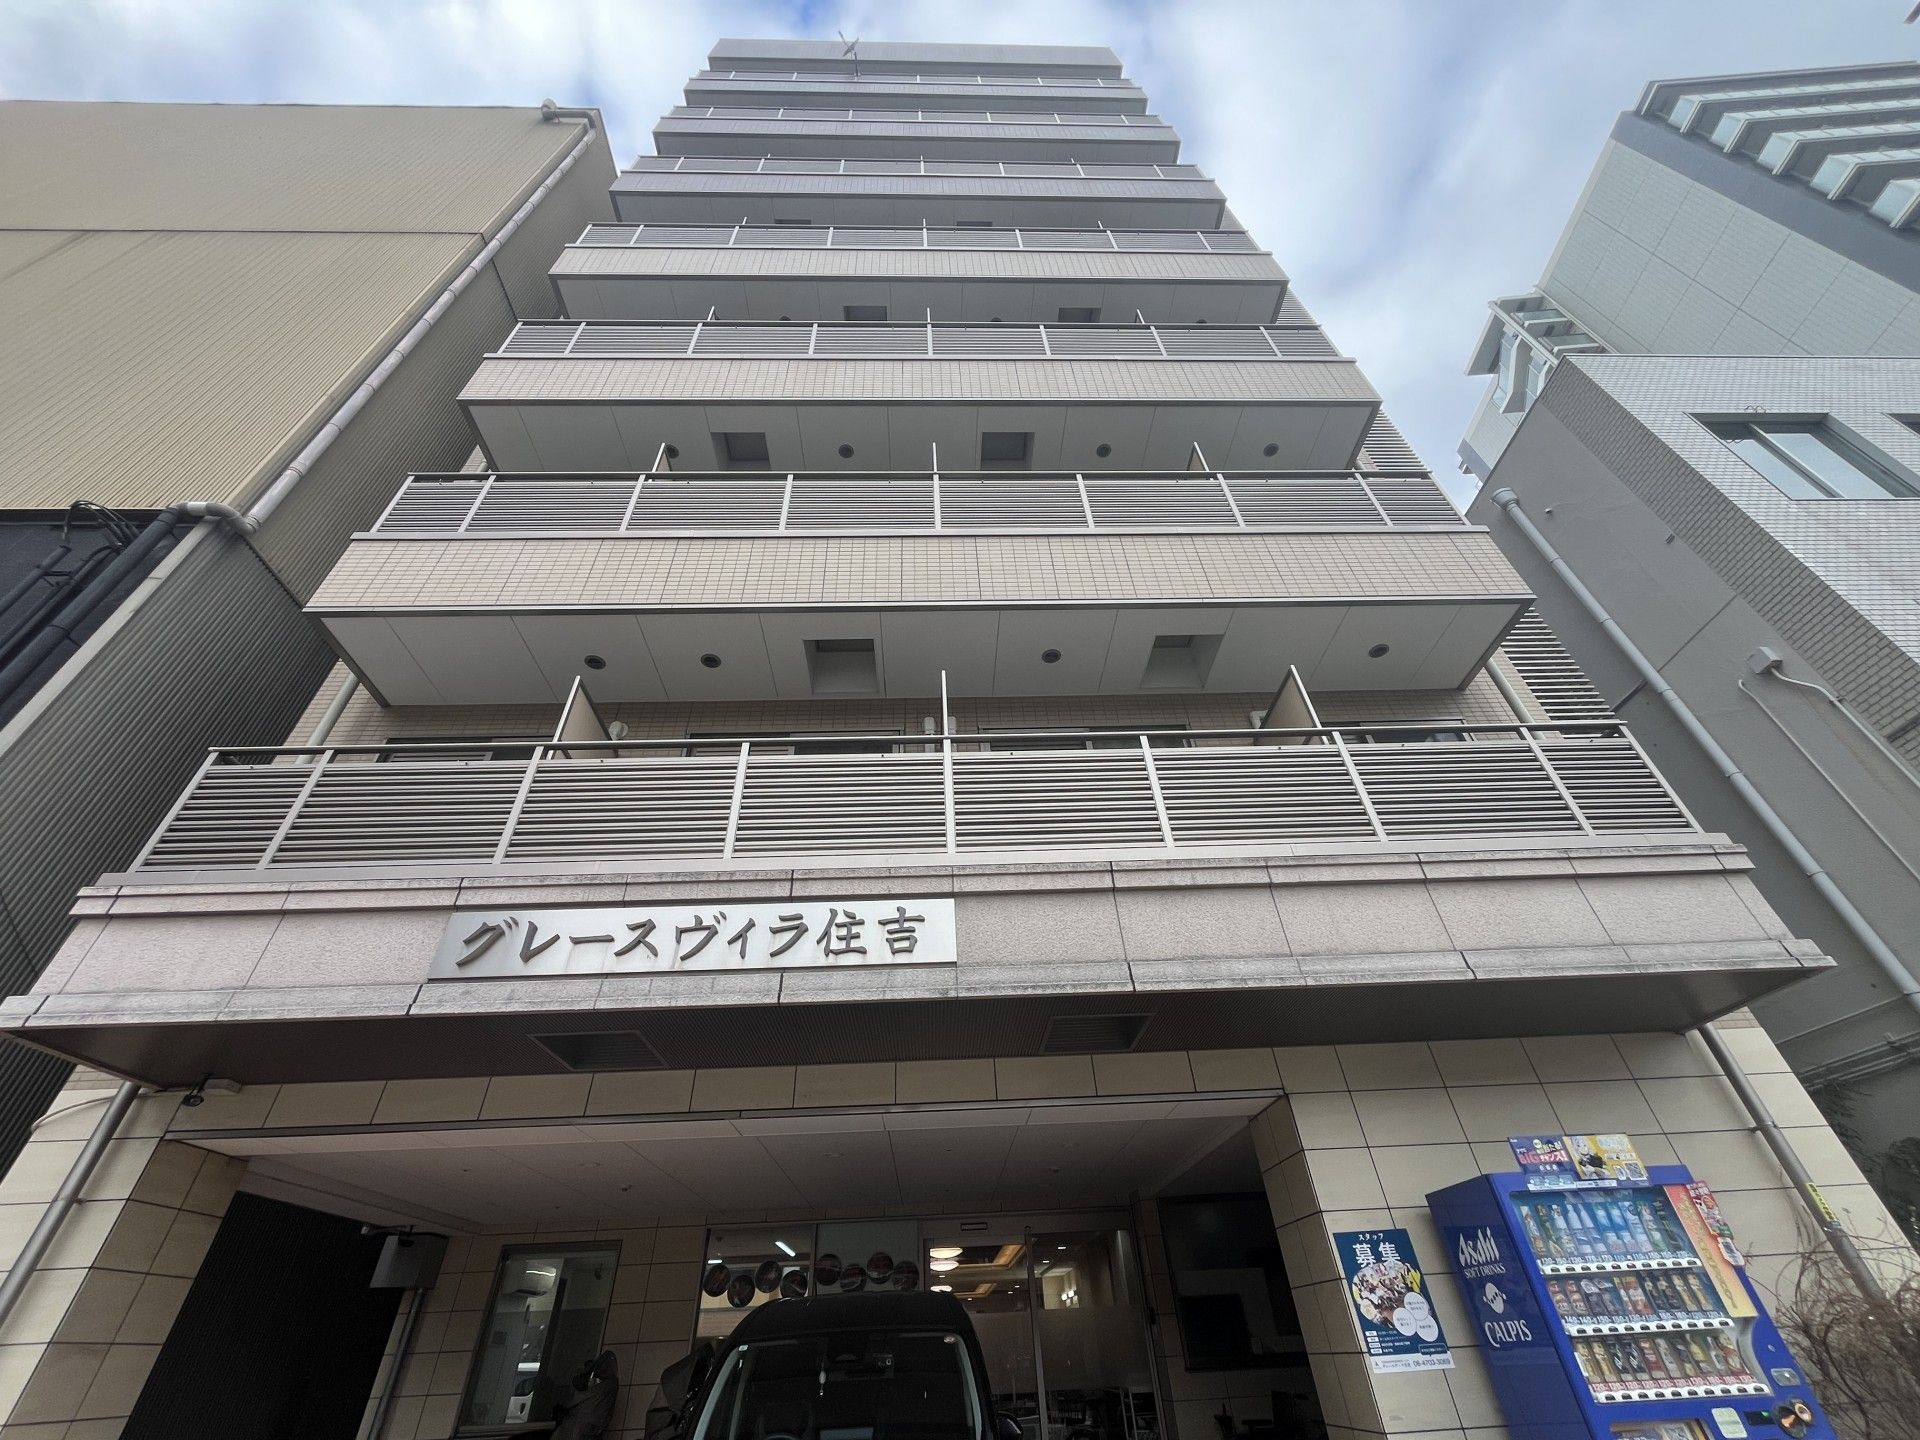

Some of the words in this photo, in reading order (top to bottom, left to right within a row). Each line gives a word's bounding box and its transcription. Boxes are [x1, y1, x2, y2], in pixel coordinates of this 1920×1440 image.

[455, 906, 925, 968] グレースヴィラ住吉
[1358, 1233, 1384, 1241] スタッフ
[1458, 1226, 1500, 1267] Asahi
[1352, 1242, 1401, 1267] 募集
[1464, 1265, 1481, 1279] SOFT
[1481, 1263, 1506, 1278] DRINKS
[1484, 1319, 1532, 1347] CALPIS
